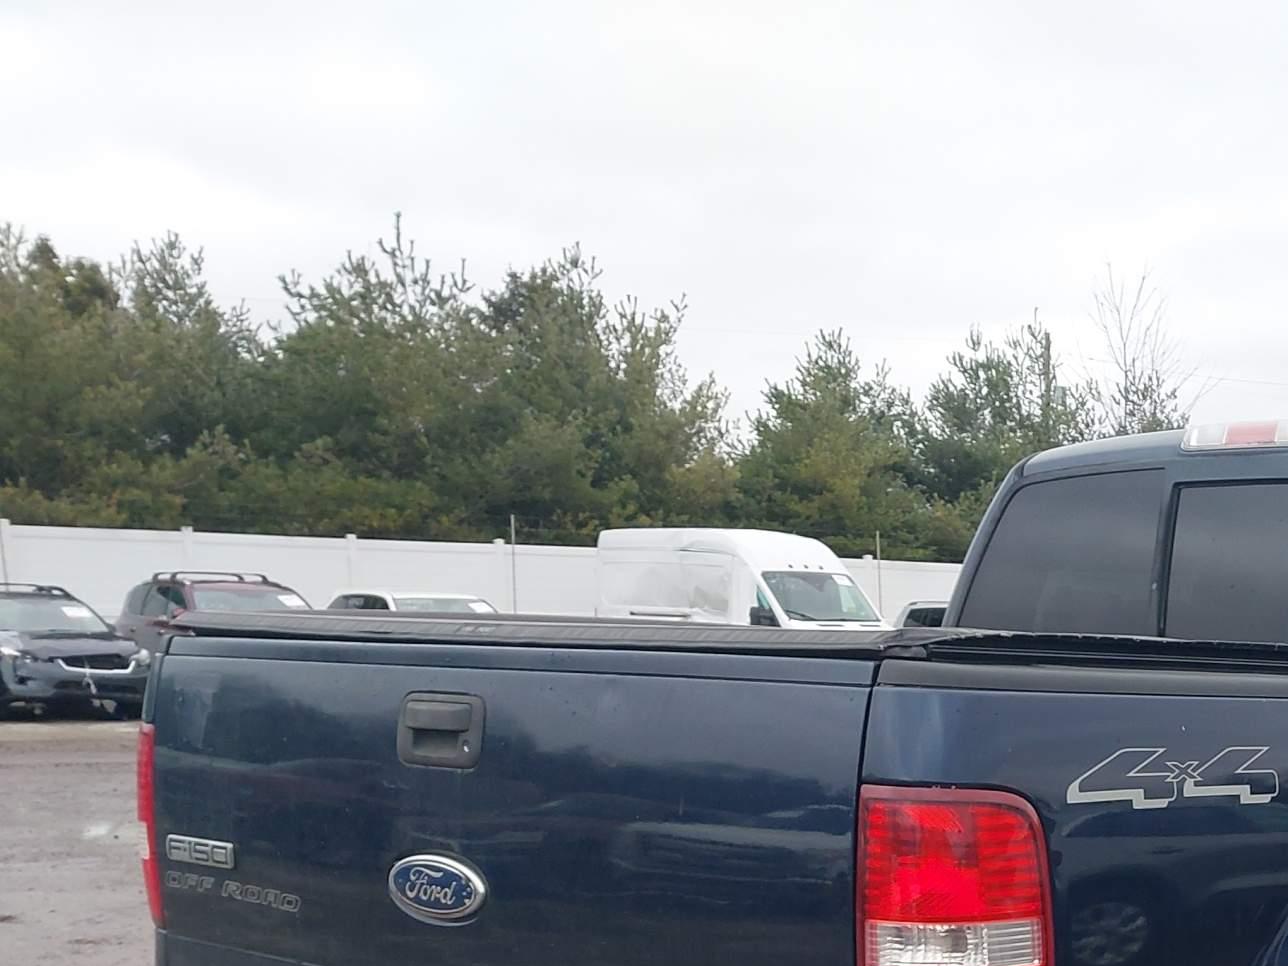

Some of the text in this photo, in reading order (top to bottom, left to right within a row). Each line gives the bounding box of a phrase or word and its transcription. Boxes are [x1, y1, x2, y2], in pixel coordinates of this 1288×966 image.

[1066, 746, 1280, 810] 4x4
[166, 870, 301, 913] OFF ROAD
[405, 866, 457, 905] Ford
